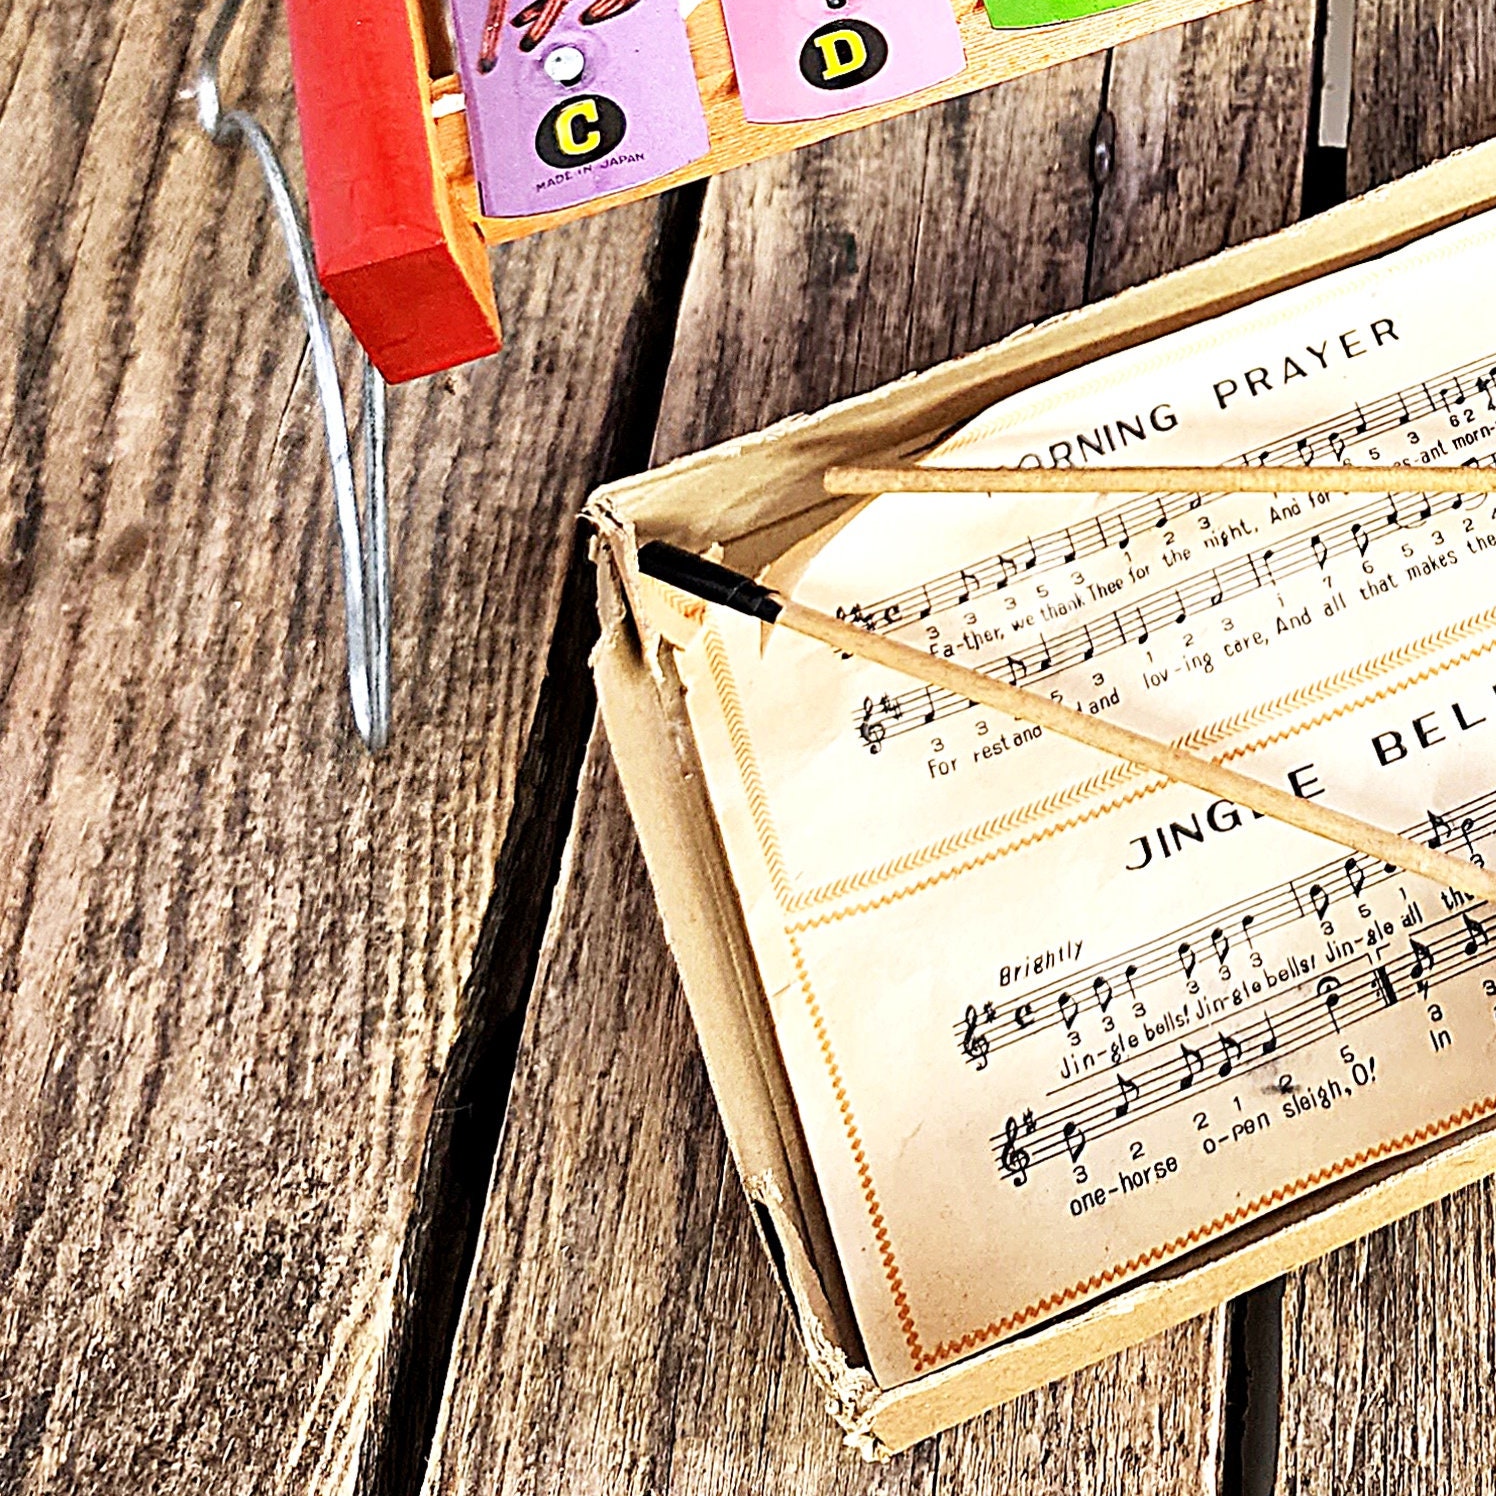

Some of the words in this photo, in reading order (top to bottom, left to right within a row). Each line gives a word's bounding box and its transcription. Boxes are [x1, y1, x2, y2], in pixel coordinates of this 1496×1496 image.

[813, 28, 867, 80] D
[536, 171, 572, 192] MADE
[578, 165, 592, 175] IN
[600, 153, 645, 169] JAPAN
[556, 100, 600, 156] C
[1018, 404, 1178, 469] ORNING
[1213, 318, 1399, 409] PRAYER
[1369, 448, 1380, 460] 5
[1407, 432, 1420, 444] 3
[1450, 415, 1460, 427] 6
[1464, 409, 1476, 423] 2
[1011, 615, 1036, 632] we
[1041, 593, 1086, 622] thank
[1086, 578, 1123, 601] Thee
[1128, 566, 1150, 583] for
[1162, 549, 1191, 567] the
[1270, 498, 1301, 524] And
[927, 756, 958, 779] For
[973, 735, 1010, 763] rest
[1090, 688, 1120, 715] and
[1223, 632, 1269, 658] care,
[1276, 607, 1312, 634] And
[1323, 593, 1348, 617] all
[1359, 573, 1398, 601] that
[1406, 549, 1458, 582] makes
[1125, 763, 1326, 872] JINGE
[1000, 940, 1082, 987] Brightly
[1060, 1034, 1139, 1078] Jin-gle
[1196, 978, 1261, 1020] Jin-gle
[1326, 918, 1394, 963] Jin-gle
[1402, 901, 1423, 928] all
[1070, 1155, 1178, 1217] one-horse
[1203, 1112, 1270, 1154] o-pen
[1283, 1079, 1352, 1118] sleigh,
[1352, 1056, 1376, 1086] O!
[1072, 1165, 1088, 1184] 3
[1130, 1142, 1145, 1160] 2
[1193, 1113, 1208, 1130] 2
[1340, 1045, 1354, 1063] 5
